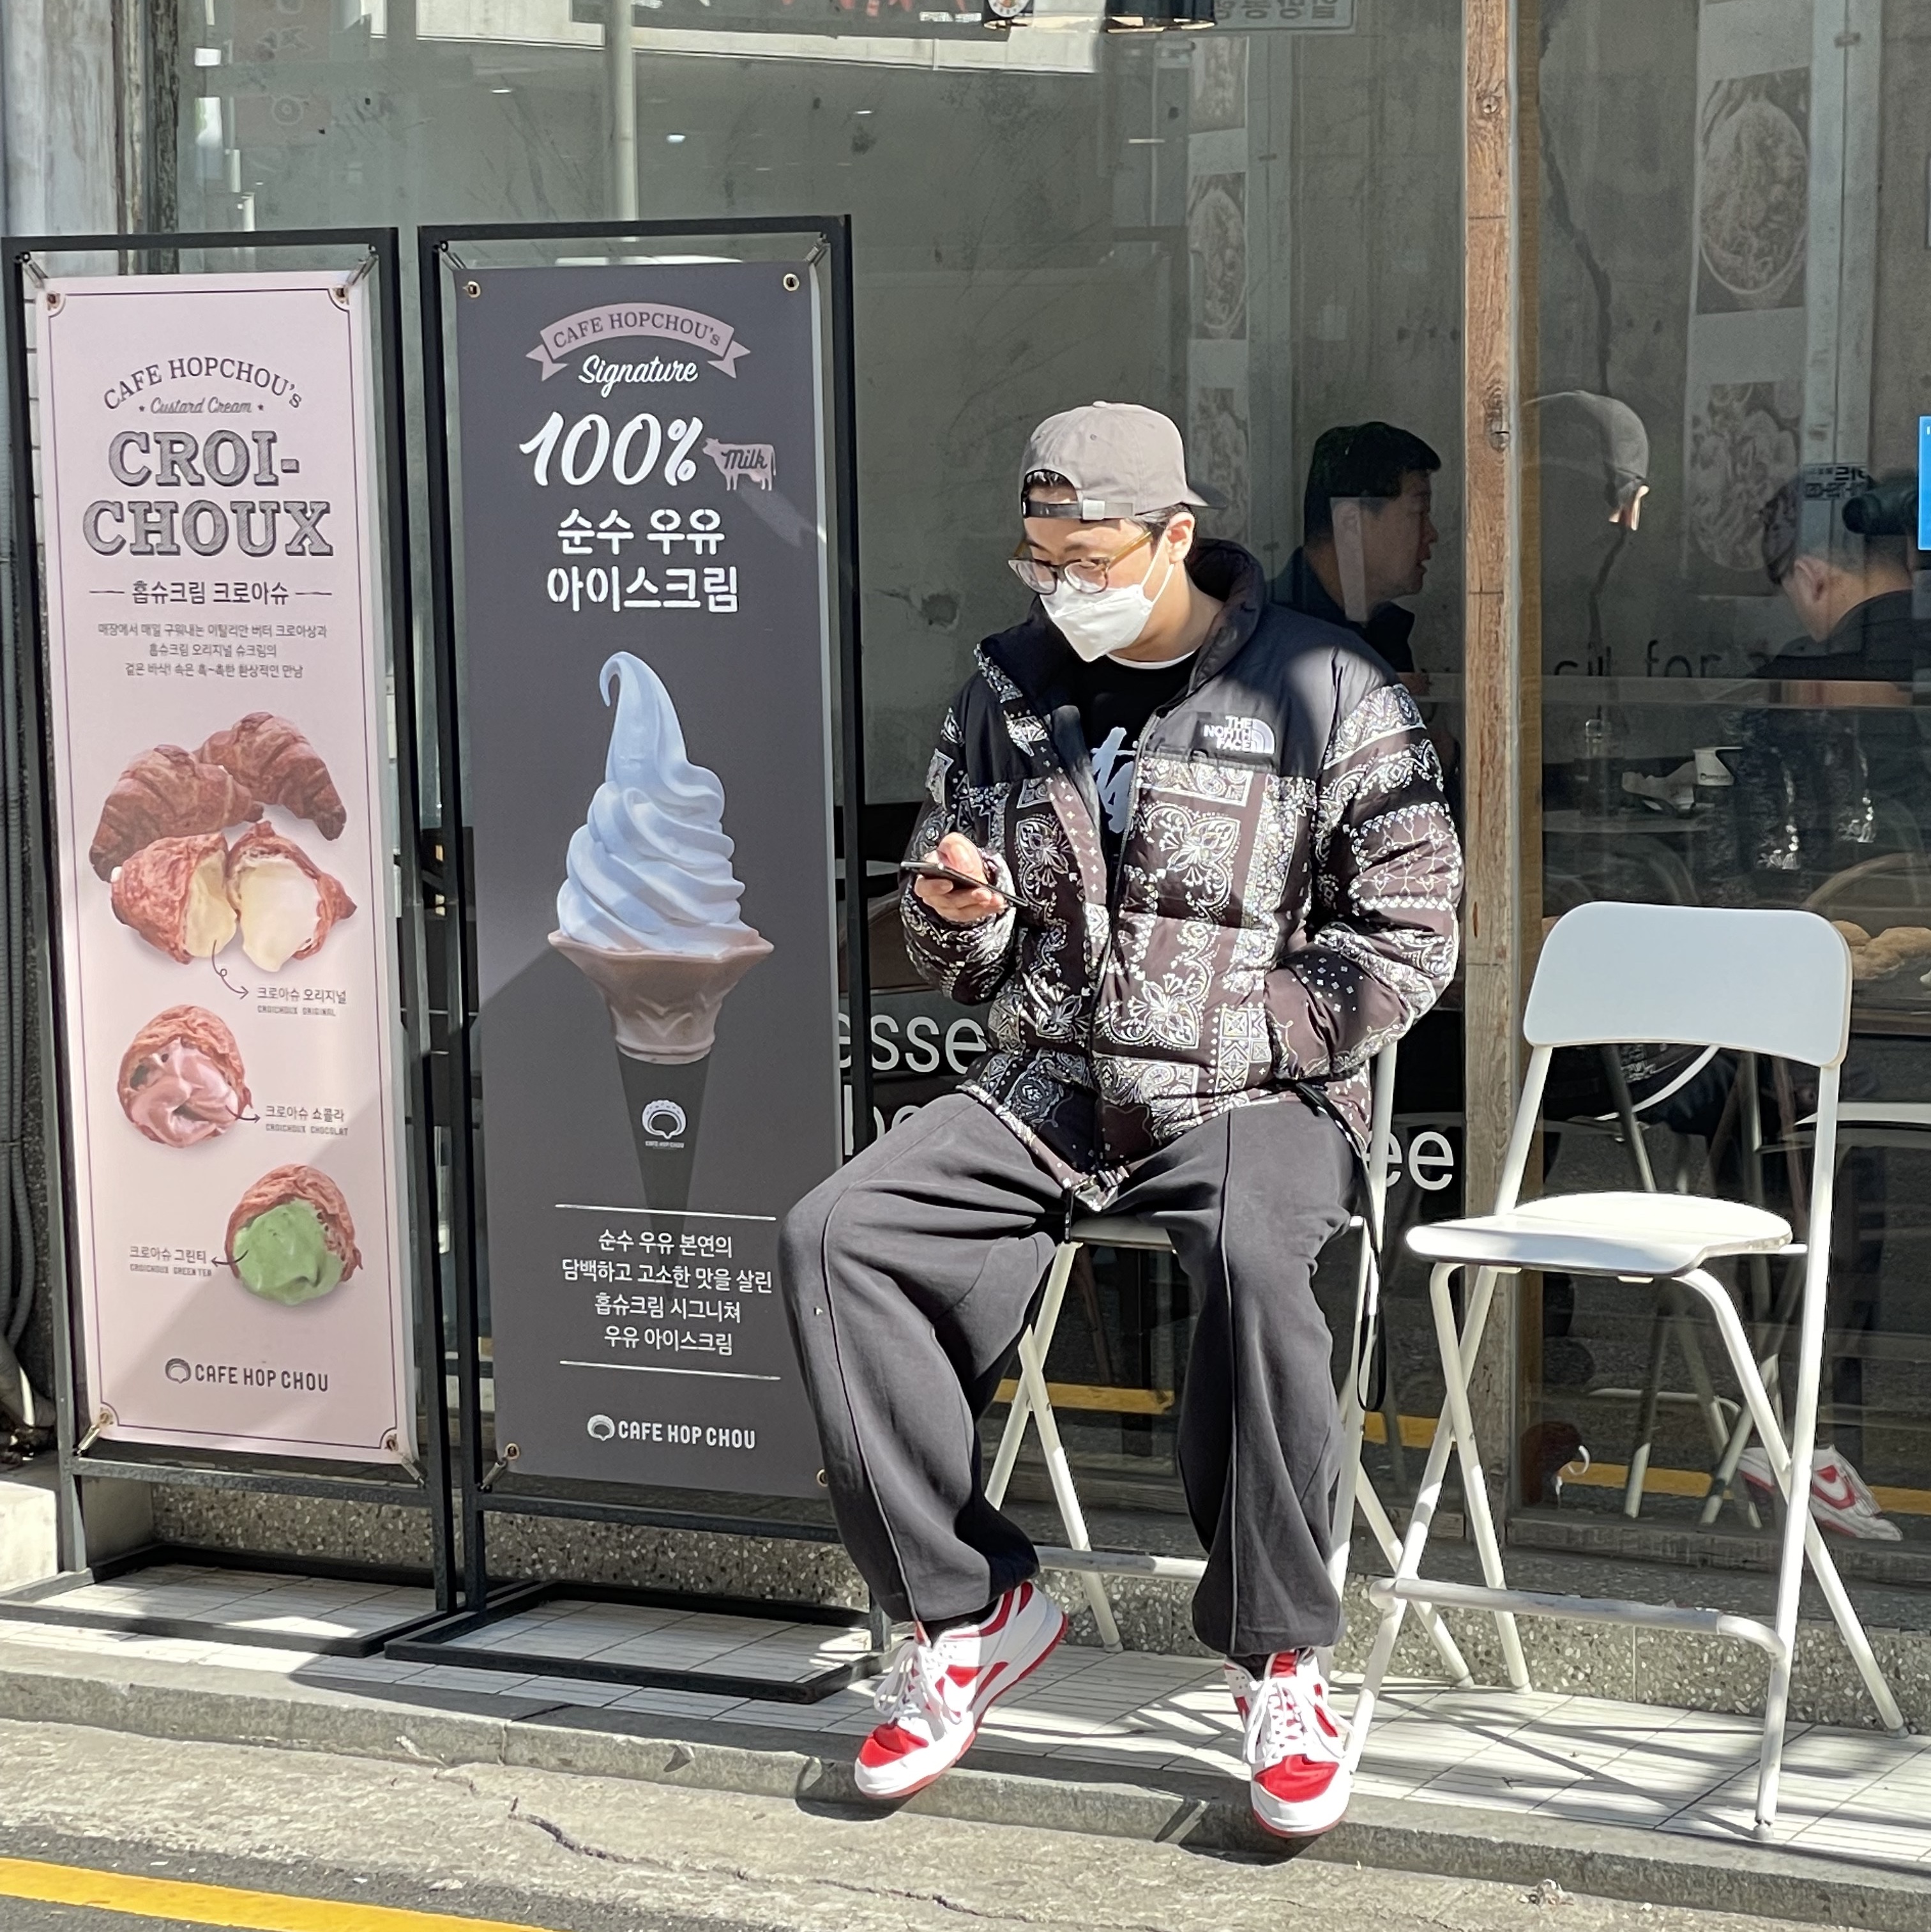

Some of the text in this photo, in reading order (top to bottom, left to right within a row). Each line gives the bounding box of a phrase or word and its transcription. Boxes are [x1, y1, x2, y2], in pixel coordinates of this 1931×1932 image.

[553, 311, 720, 349] CAFE HOPCHOU's
[103, 356, 303, 409] CAFE HOPCHOU's
[578, 354, 699, 398] Signature
[150, 396, 252, 415] Custard Cream
[109, 429, 300, 487] CROI-
[519, 411, 703, 487] 100%
[82, 499, 334, 558] CHOUX
[557, 508, 725, 555] 순수 우유
[132, 580, 289, 605] 홉슈크림 크로아슈
[547, 566, 739, 612] 아이스크림
[1203, 724, 1252, 741] NORTH
[1225, 715, 1252, 729] THE
[1216, 738, 1252, 752] FACE
[257, 987, 347, 1005] 크로아슈 오리지널
[265, 1105, 345, 1123] 크로아슈 쇼콜라
[129, 1245, 207, 1264] 크로아슈 그린티
[598, 1229, 732, 1259] 순수 우유 본연의
[562, 1258, 772, 1294] 담백하고 고소한 맛을 살린
[594, 1292, 741, 1324] 홉슈크림 시그니쳐
[604, 1325, 732, 1356] 우유 아이스크림
[195, 1364, 328, 1392] CAFE HOP CHOU
[618, 1420, 755, 1449] CAFE HOP CHOU
